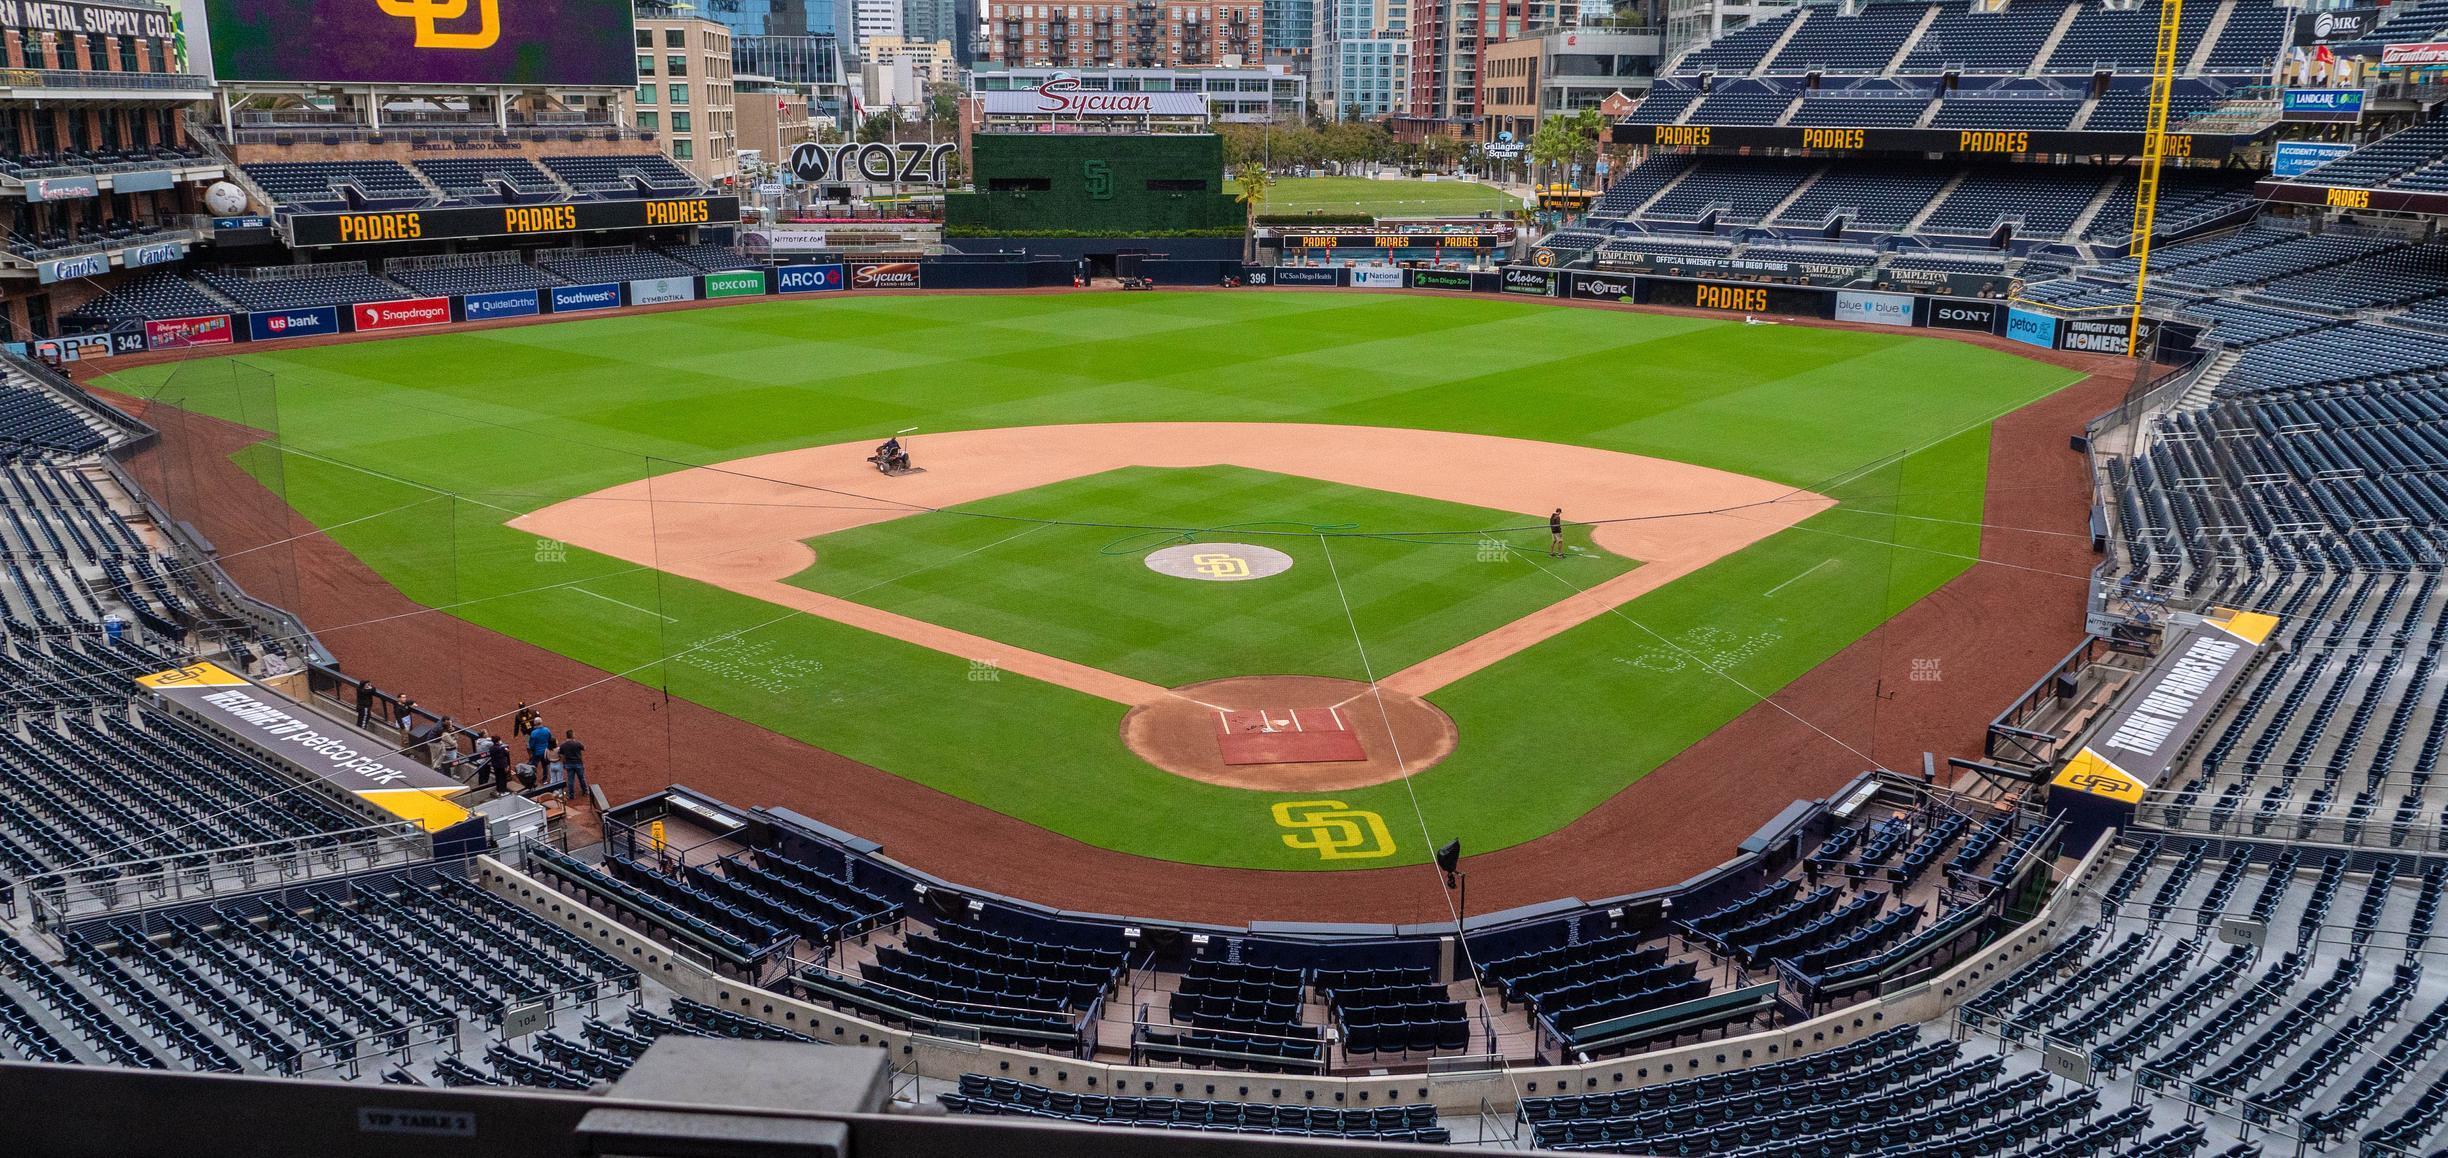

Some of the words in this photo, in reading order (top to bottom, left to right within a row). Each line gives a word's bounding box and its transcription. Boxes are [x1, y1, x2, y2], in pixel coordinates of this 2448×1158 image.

[25, 2, 82, 32] METAL
[83, 8, 140, 36] SUPPLY
[145, 13, 169, 38] CO.
[2333, 16, 2361, 29] MRC
[1037, 78, 1154, 121] Sycuan
[2296, 93, 2336, 106] LANDCARE
[2336, 93, 2361, 104] LOGIC
[1655, 126, 1710, 146] PADRES
[1803, 128, 1864, 149] PADRES
[1960, 131, 2028, 152] PADRES
[412, 143, 453, 151] ESTRELLA
[455, 143, 486, 151] JALISCO
[1483, 142, 1524, 152] Gallagher
[1489, 150, 1518, 159] Square
[835, 142, 957, 183] razr
[2327, 188, 2369, 208] PADRES
[505, 206, 576, 233] PADRES
[646, 200, 709, 225] PADRES
[339, 213, 421, 242] PADRES
[1303, 237, 1337, 247] PADRES
[1375, 236, 1409, 247] PADRES
[1445, 236, 1479, 247] PADRES
[137, 245, 174, 265] Canel's
[1597, 251, 1644, 262] TEMPLETON
[1656, 255, 1685, 265] OFFICIAL
[1686, 258, 1716, 267] WHISKEY
[1732, 260, 1744, 268] SAN
[1745, 261, 1763, 270] DIEGO
[1764, 262, 1788, 271] PADRES
[55, 257, 99, 281] Canel's
[856, 265, 914, 287] Sycuan
[1300, 273, 1314, 281] Diego
[1369, 272, 1400, 280] National
[1506, 270, 1545, 284] Chosen
[1800, 264, 1855, 276] TEMPLETON
[1889, 269, 1948, 283] TEMPLETON
[781, 272, 825, 287] ARCO
[1250, 273, 1267, 284] 396
[1440, 277, 1457, 286] Diego
[1577, 280, 1628, 295] EVOTEK
[482, 298, 535, 312] QuidelOrtho
[557, 289, 609, 306] Southwest
[642, 293, 685, 304] CYMBIOTIKA
[1696, 284, 1768, 312] PADRES
[383, 306, 444, 321] Snapdragon
[1839, 299, 1862, 310] blue
[1875, 302, 1899, 314] blue
[270, 317, 286, 330] us
[287, 314, 319, 328] bank
[1939, 309, 1990, 323] SONY
[2010, 316, 2038, 335] petco
[2072, 321, 2108, 334] HUNGRY
[2109, 323, 2127, 335] FOR
[39, 336, 110, 360] ORS
[118, 334, 143, 351] 342
[2066, 333, 2130, 353] HOMERS
[2185, 636, 2241, 666] FANS
[2155, 657, 2224, 695] PADRES
[201, 689, 292, 730] WELCOME
[2137, 690, 2200, 720] YOU
[275, 719, 309, 742] TO
[2105, 711, 2179, 757] THANK
[289, 730, 356, 763] petco
[342, 755, 408, 785] park
[1271, 799, 1397, 860] SD
[2232, 927, 2252, 940] 103
[517, 1014, 536, 1028] 104
[2056, 1056, 2075, 1071] 101
[367, 1112, 393, 1125] VIP
[398, 1114, 452, 1129] TABLE
[456, 1117, 467, 1130] 2
